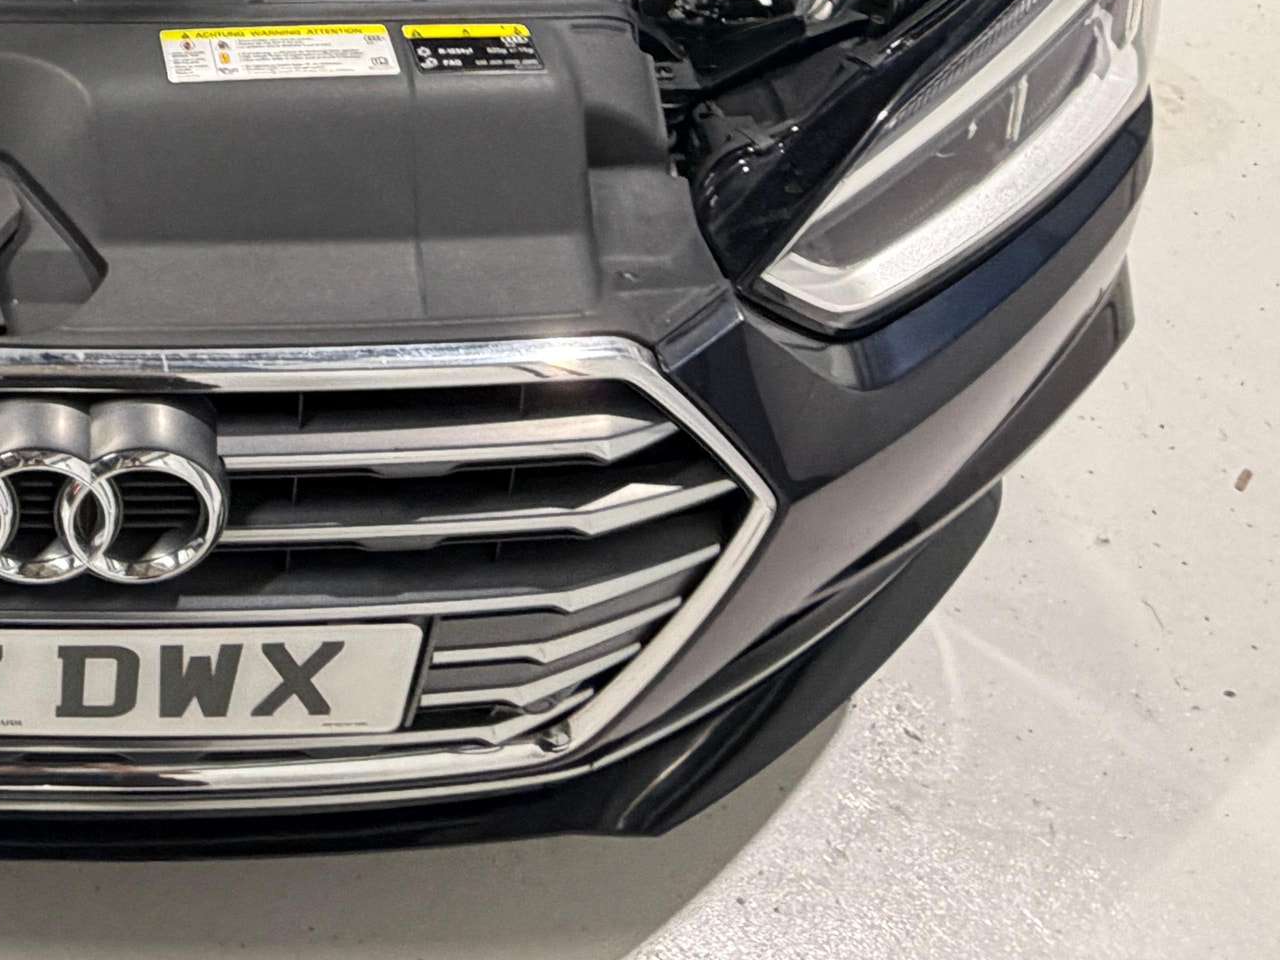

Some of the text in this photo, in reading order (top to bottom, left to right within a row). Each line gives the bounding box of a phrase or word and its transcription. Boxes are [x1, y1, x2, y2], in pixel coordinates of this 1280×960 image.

[195, 27, 364, 38] ACHTUNG WARNING ATTENTION
[56, 641, 345, 718] DWX
